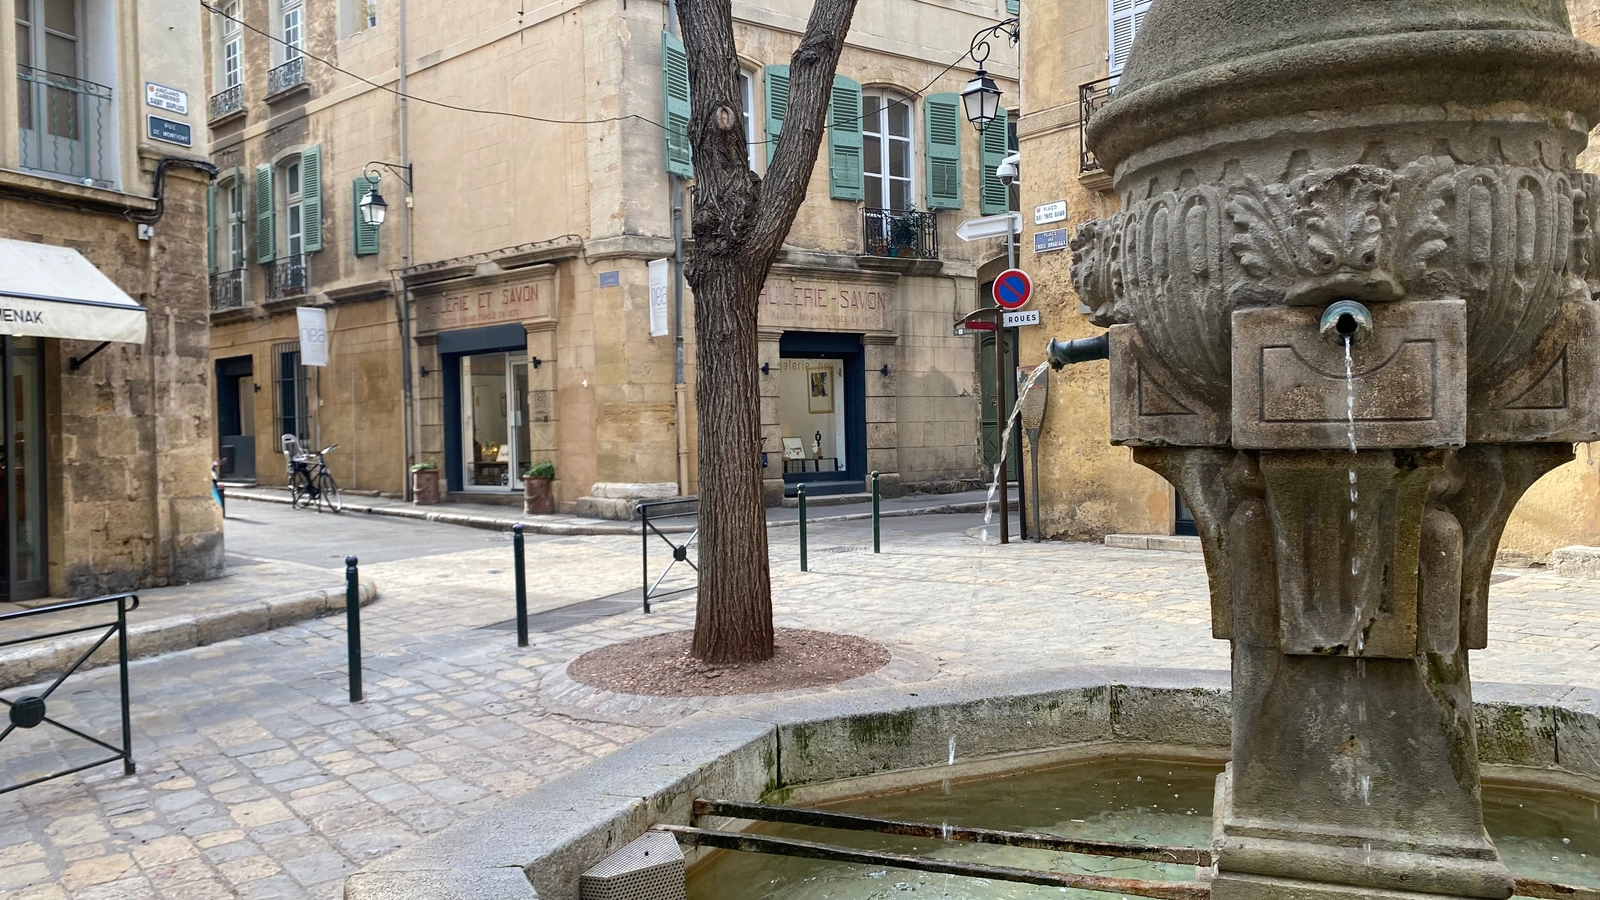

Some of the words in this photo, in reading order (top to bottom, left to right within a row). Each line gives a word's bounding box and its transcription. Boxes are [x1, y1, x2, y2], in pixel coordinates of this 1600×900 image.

[163, 122, 176, 131] RUE
[152, 128, 160, 136] DE
[162, 131, 189, 141] MONTIGNY
[477, 291, 493, 309] ET
[501, 284, 539, 305] SAVON
[840, 290, 887, 311] SAVON
[0, 308, 44, 324] ENAK
[1008, 314, 1037, 323] ROUES
[301, 327, 326, 344] nea
[779, 360, 810, 373] galerie
